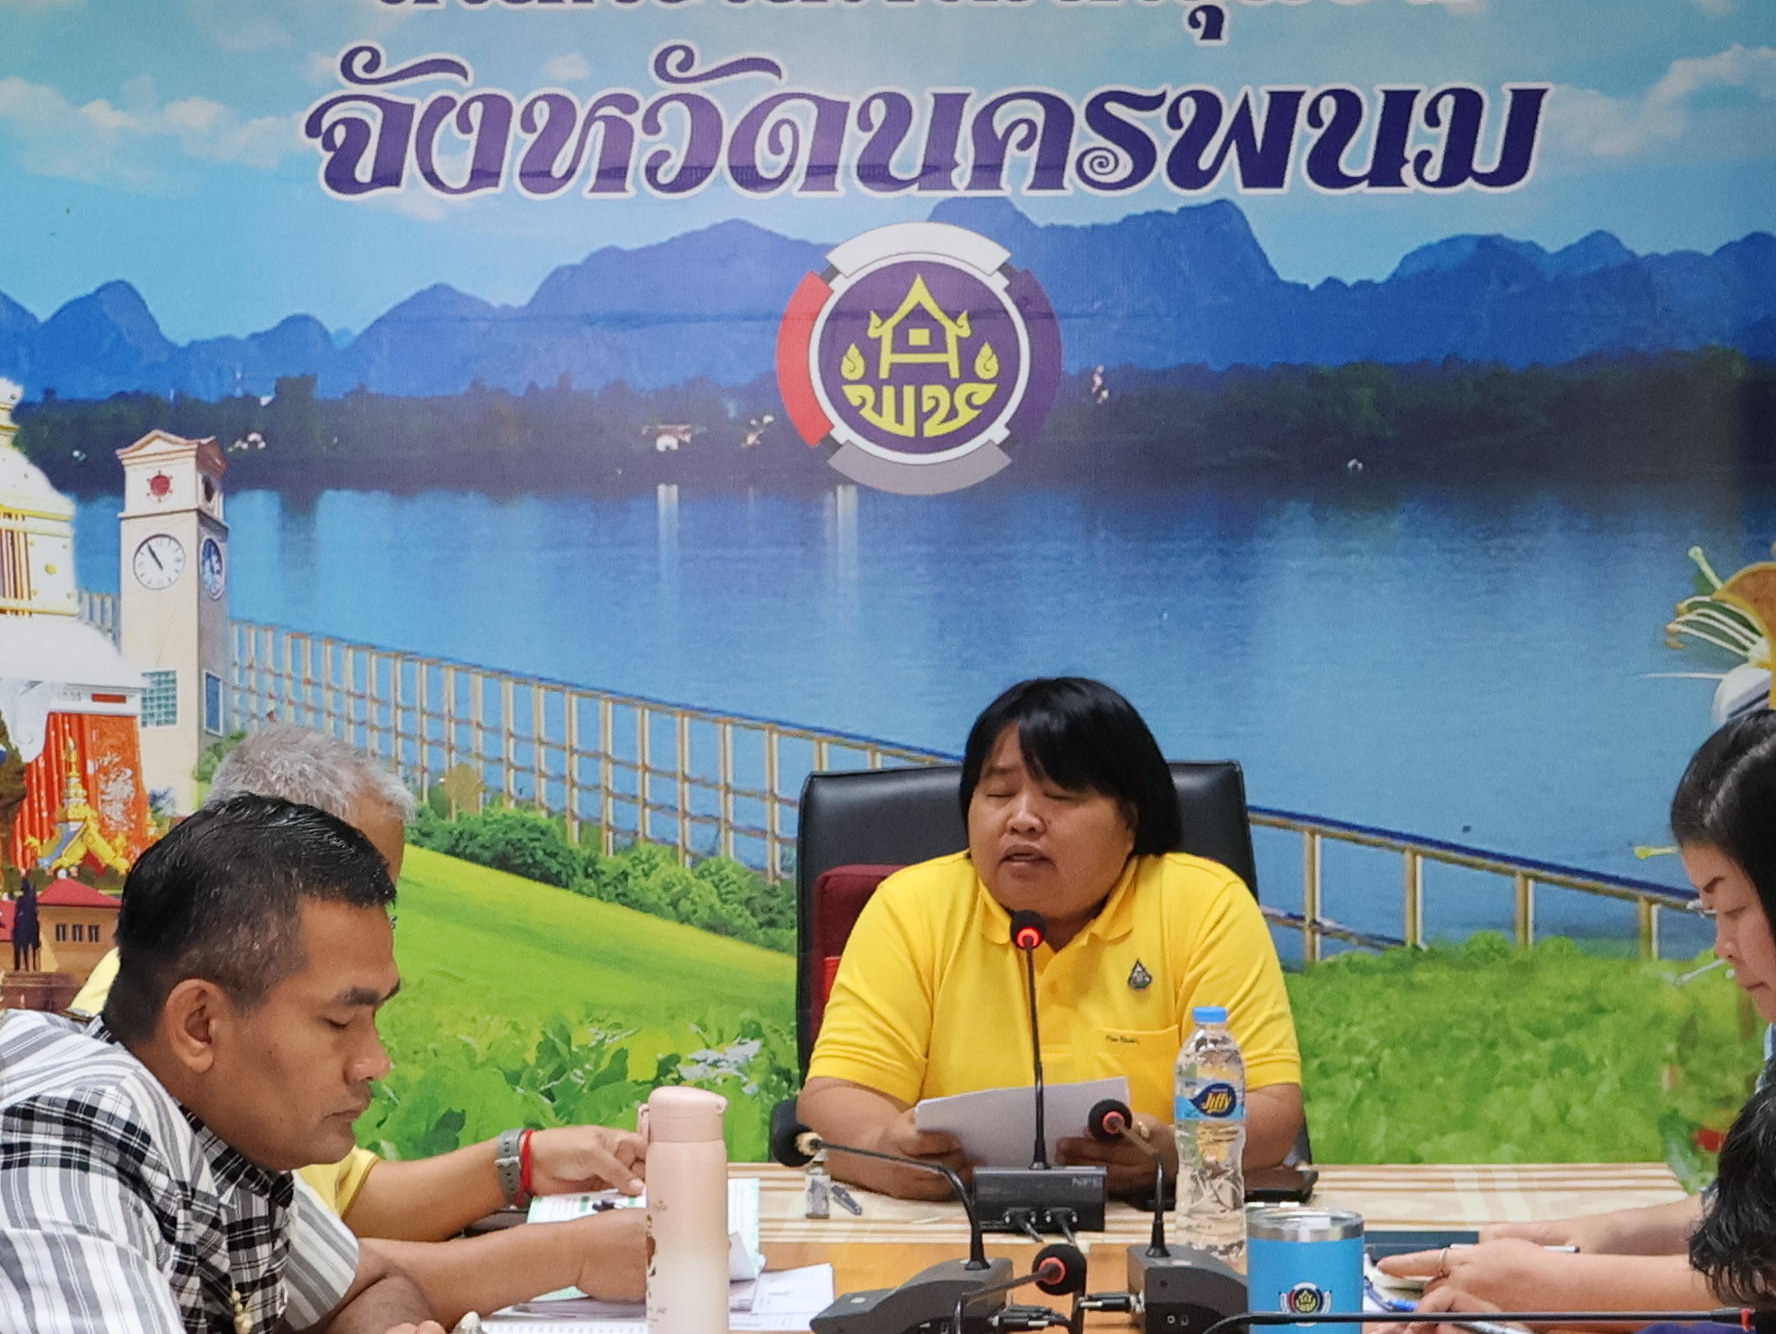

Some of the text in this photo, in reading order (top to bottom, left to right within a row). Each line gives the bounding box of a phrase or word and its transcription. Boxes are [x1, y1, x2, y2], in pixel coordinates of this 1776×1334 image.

[305, 46, 1550, 196] จังหวัดนครพนม
[1201, 1092, 1232, 1113] Jiffy
